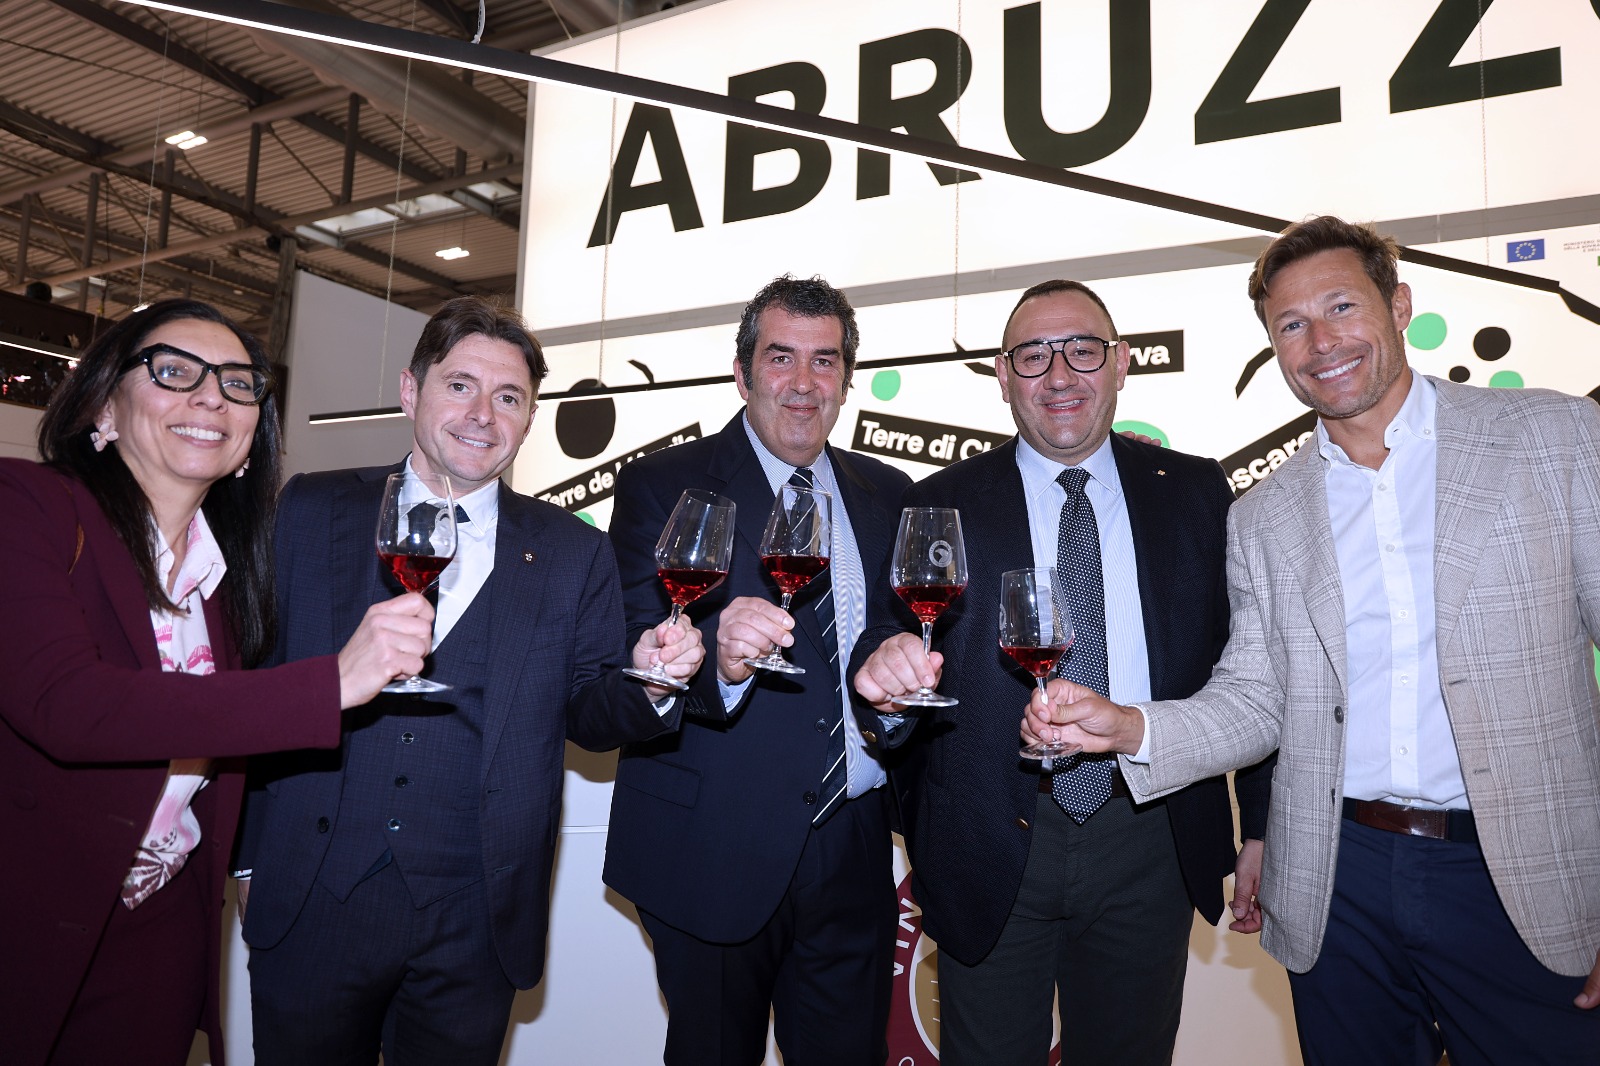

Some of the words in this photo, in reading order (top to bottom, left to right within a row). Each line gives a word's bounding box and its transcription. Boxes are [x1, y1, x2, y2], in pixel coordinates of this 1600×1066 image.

[586, 0, 1600, 248] ABRUZZ
[861, 420, 925, 455] Terre
[928, 434, 957, 461] di
[588, 470, 614, 494] de
